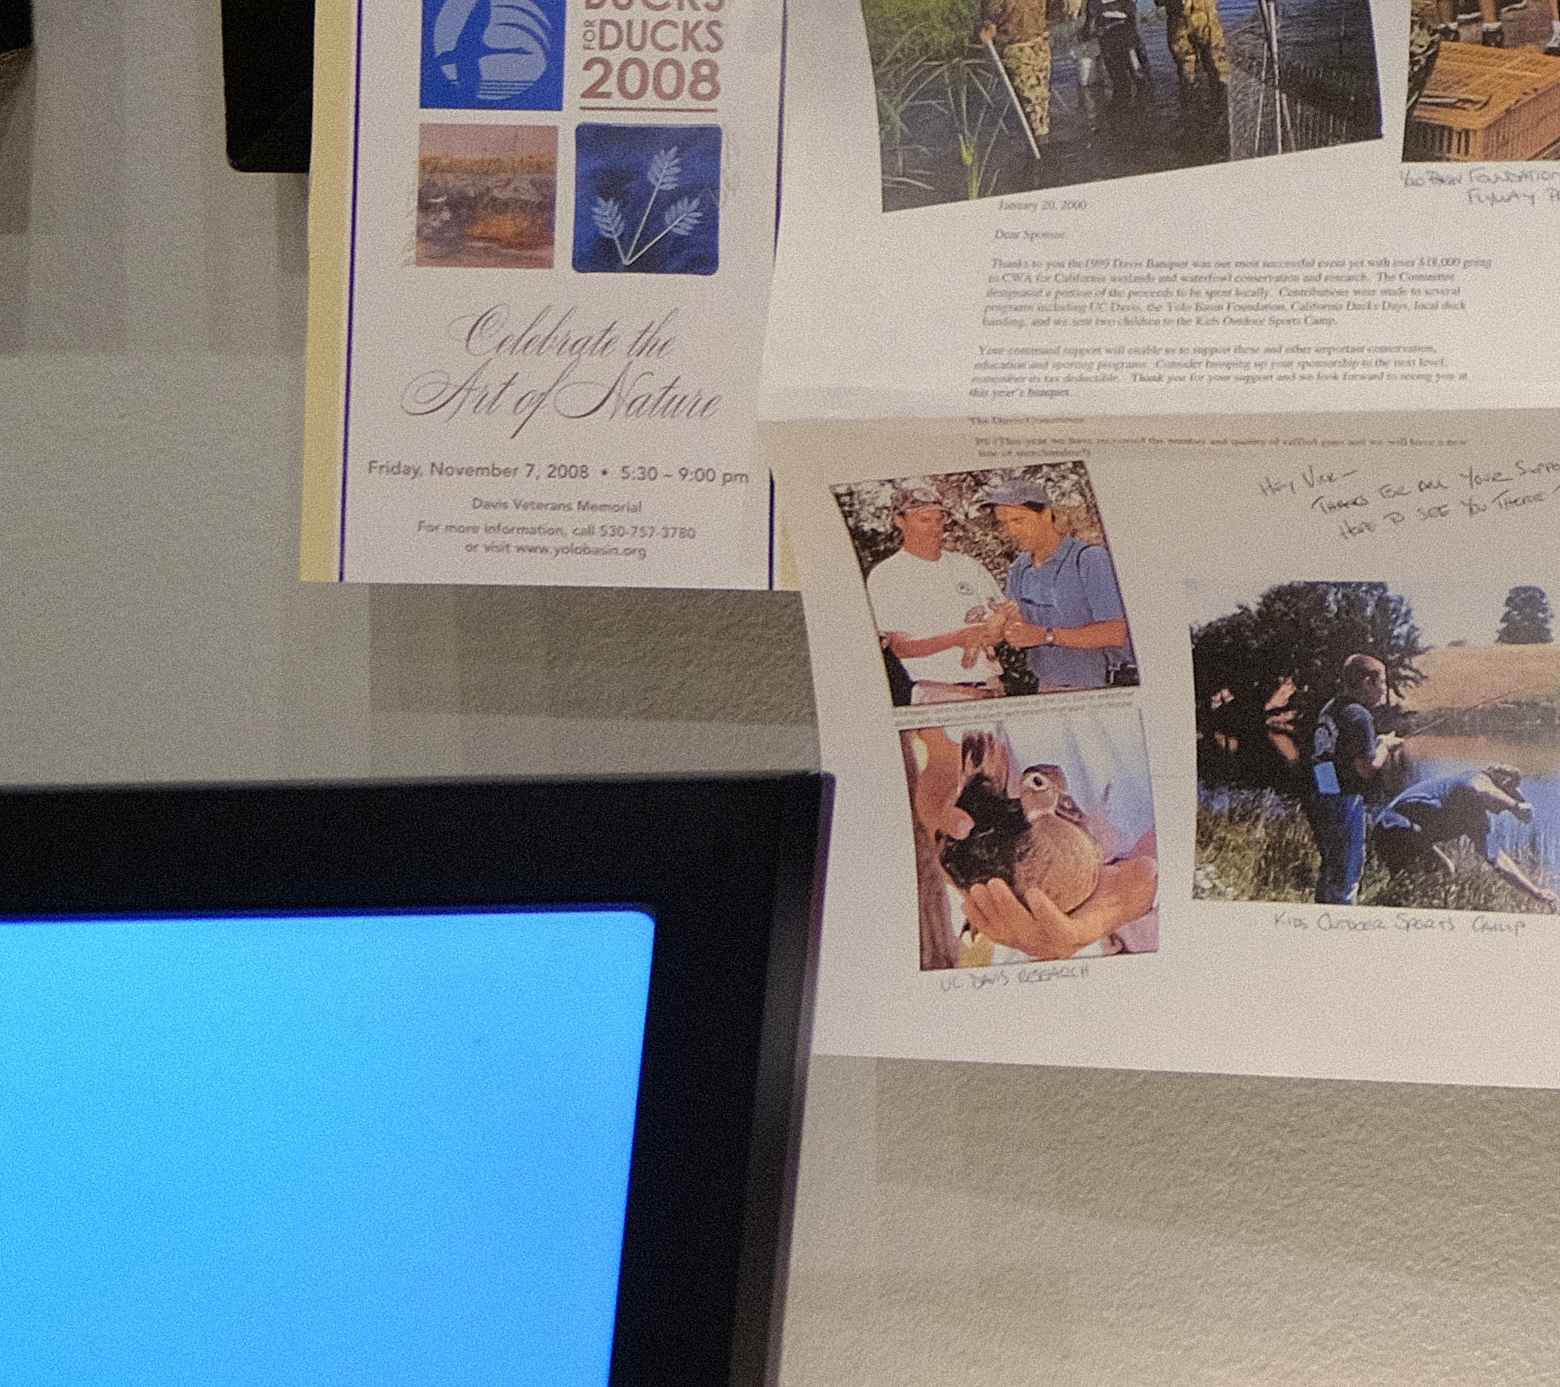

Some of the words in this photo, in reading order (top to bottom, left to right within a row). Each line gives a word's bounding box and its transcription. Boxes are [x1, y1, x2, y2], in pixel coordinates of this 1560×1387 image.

[582, 19, 596, 51] FOR
[601, 18, 723, 53] DUCKS
[581, 57, 721, 101] 2008
[368, 461, 423, 479] Friday,
[430, 462, 518, 477] November
[525, 464, 541, 479] 7,
[547, 464, 589, 479] 2008
[620, 466, 658, 482] 5:30
[679, 467, 715, 483] 9:00
[722, 471, 749, 486] pm
